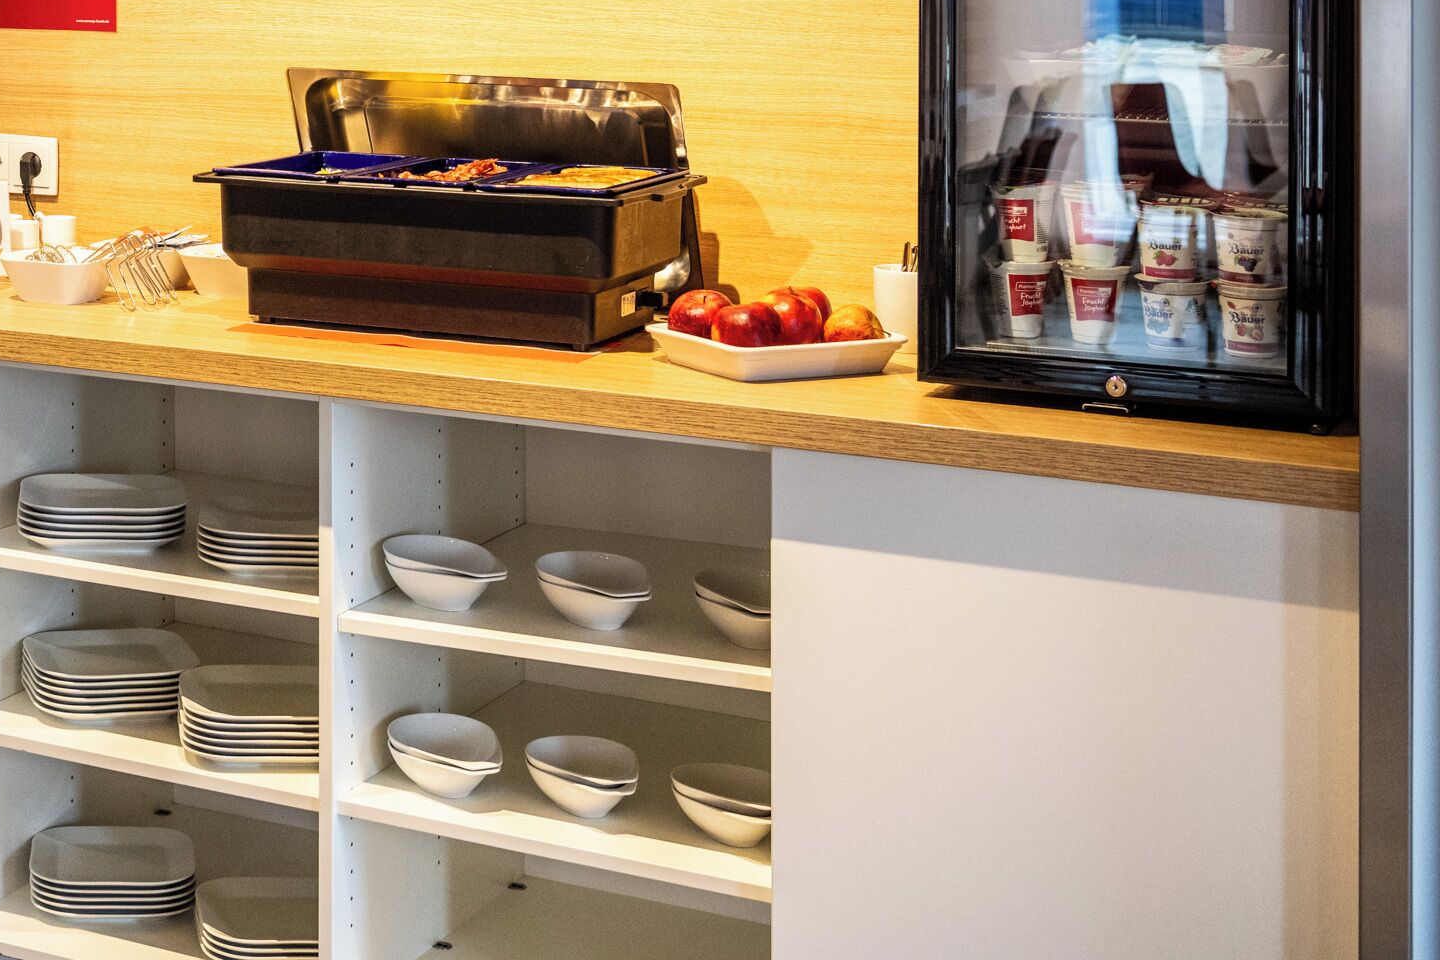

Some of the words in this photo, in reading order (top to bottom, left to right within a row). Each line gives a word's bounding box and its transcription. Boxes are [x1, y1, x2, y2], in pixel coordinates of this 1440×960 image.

[1227, 242, 1265, 255] Bauer
[1082, 296, 1105, 306] Frucht
[1229, 311, 1266, 325] Bauer
